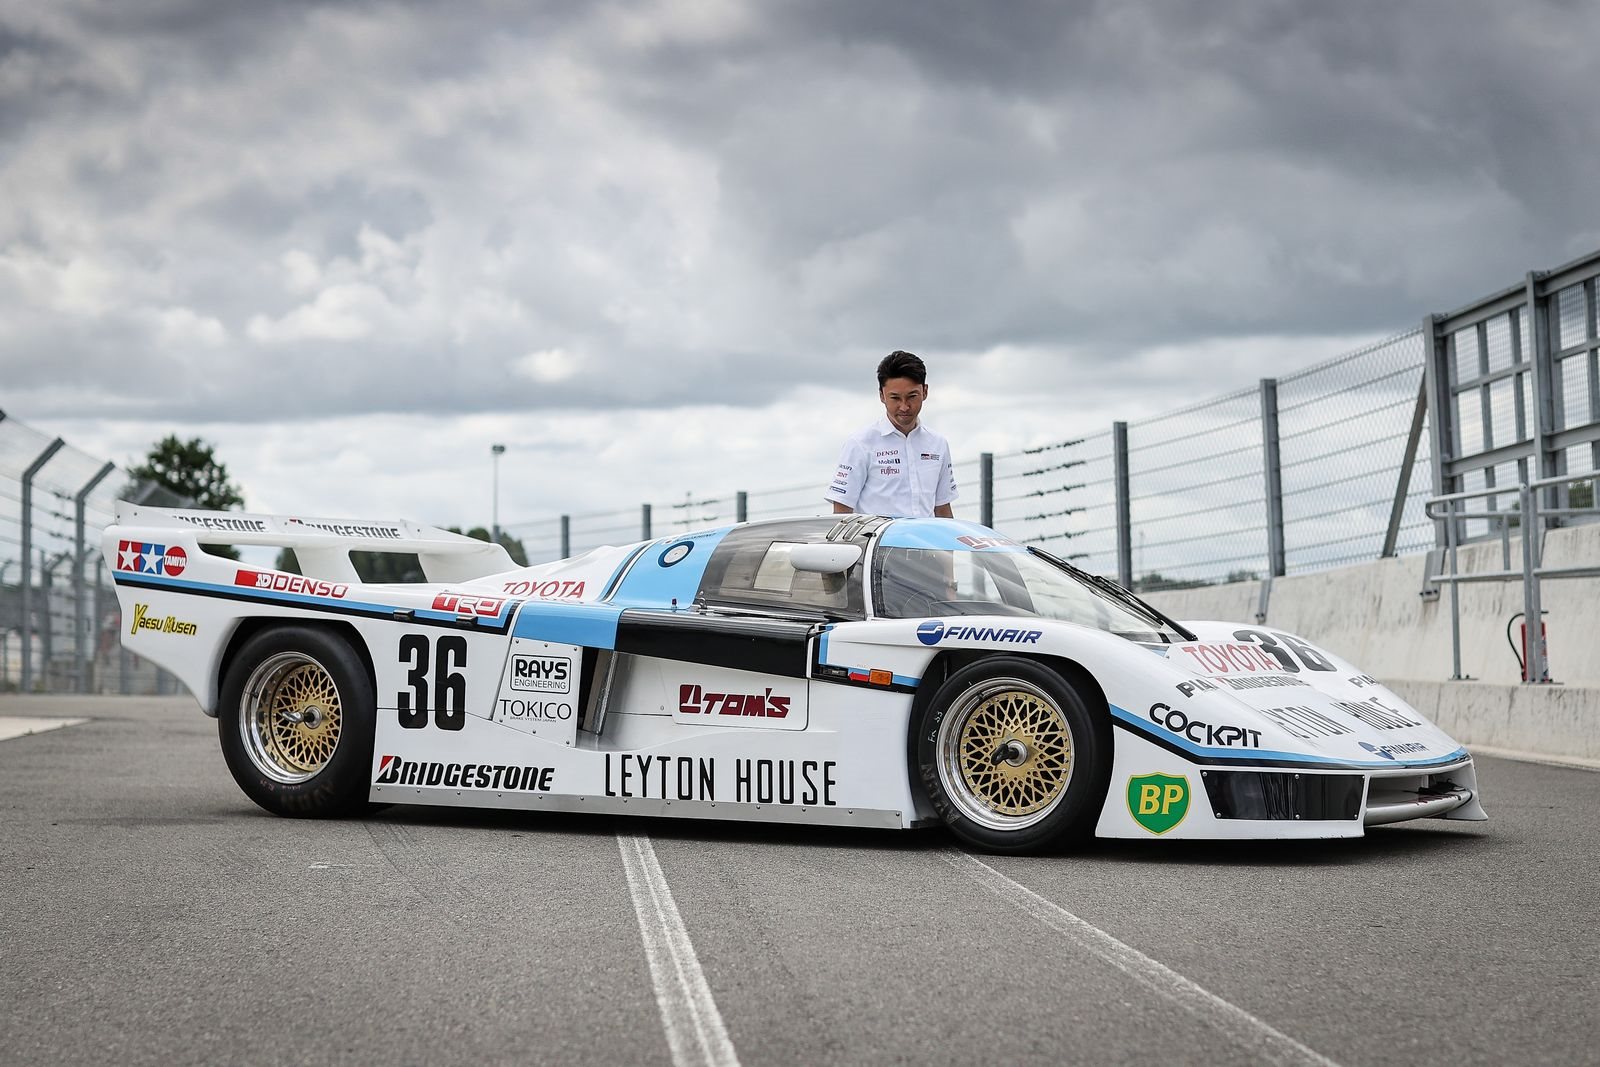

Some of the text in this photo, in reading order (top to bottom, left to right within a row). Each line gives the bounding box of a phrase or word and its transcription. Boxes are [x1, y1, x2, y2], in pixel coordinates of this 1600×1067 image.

[880, 466, 900, 476] FUJITSU
[164, 554, 188, 568] TAMIYA
[273, 574, 349, 599] DENSO
[503, 580, 586, 599] TOYOTA
[943, 626, 1043, 644] FINNAIR
[1184, 643, 1282, 674] TOYOTA
[1233, 629, 1338, 674] 36
[397, 634, 468, 731] 36
[515, 659, 568, 680] RAYS
[514, 678, 567, 690] ENGINEERING
[499, 699, 572, 720] TOKICO
[702, 687, 791, 719] TOM'S
[1329, 696, 1421, 731] HOUSE
[1149, 702, 1262, 748] COCKPIT
[1379, 742, 1430, 755] FINNAIR
[375, 755, 555, 792] BRIDGESTONE
[605, 753, 837, 806] LEYTON HOUSE
[1138, 784, 1184, 815] BP
